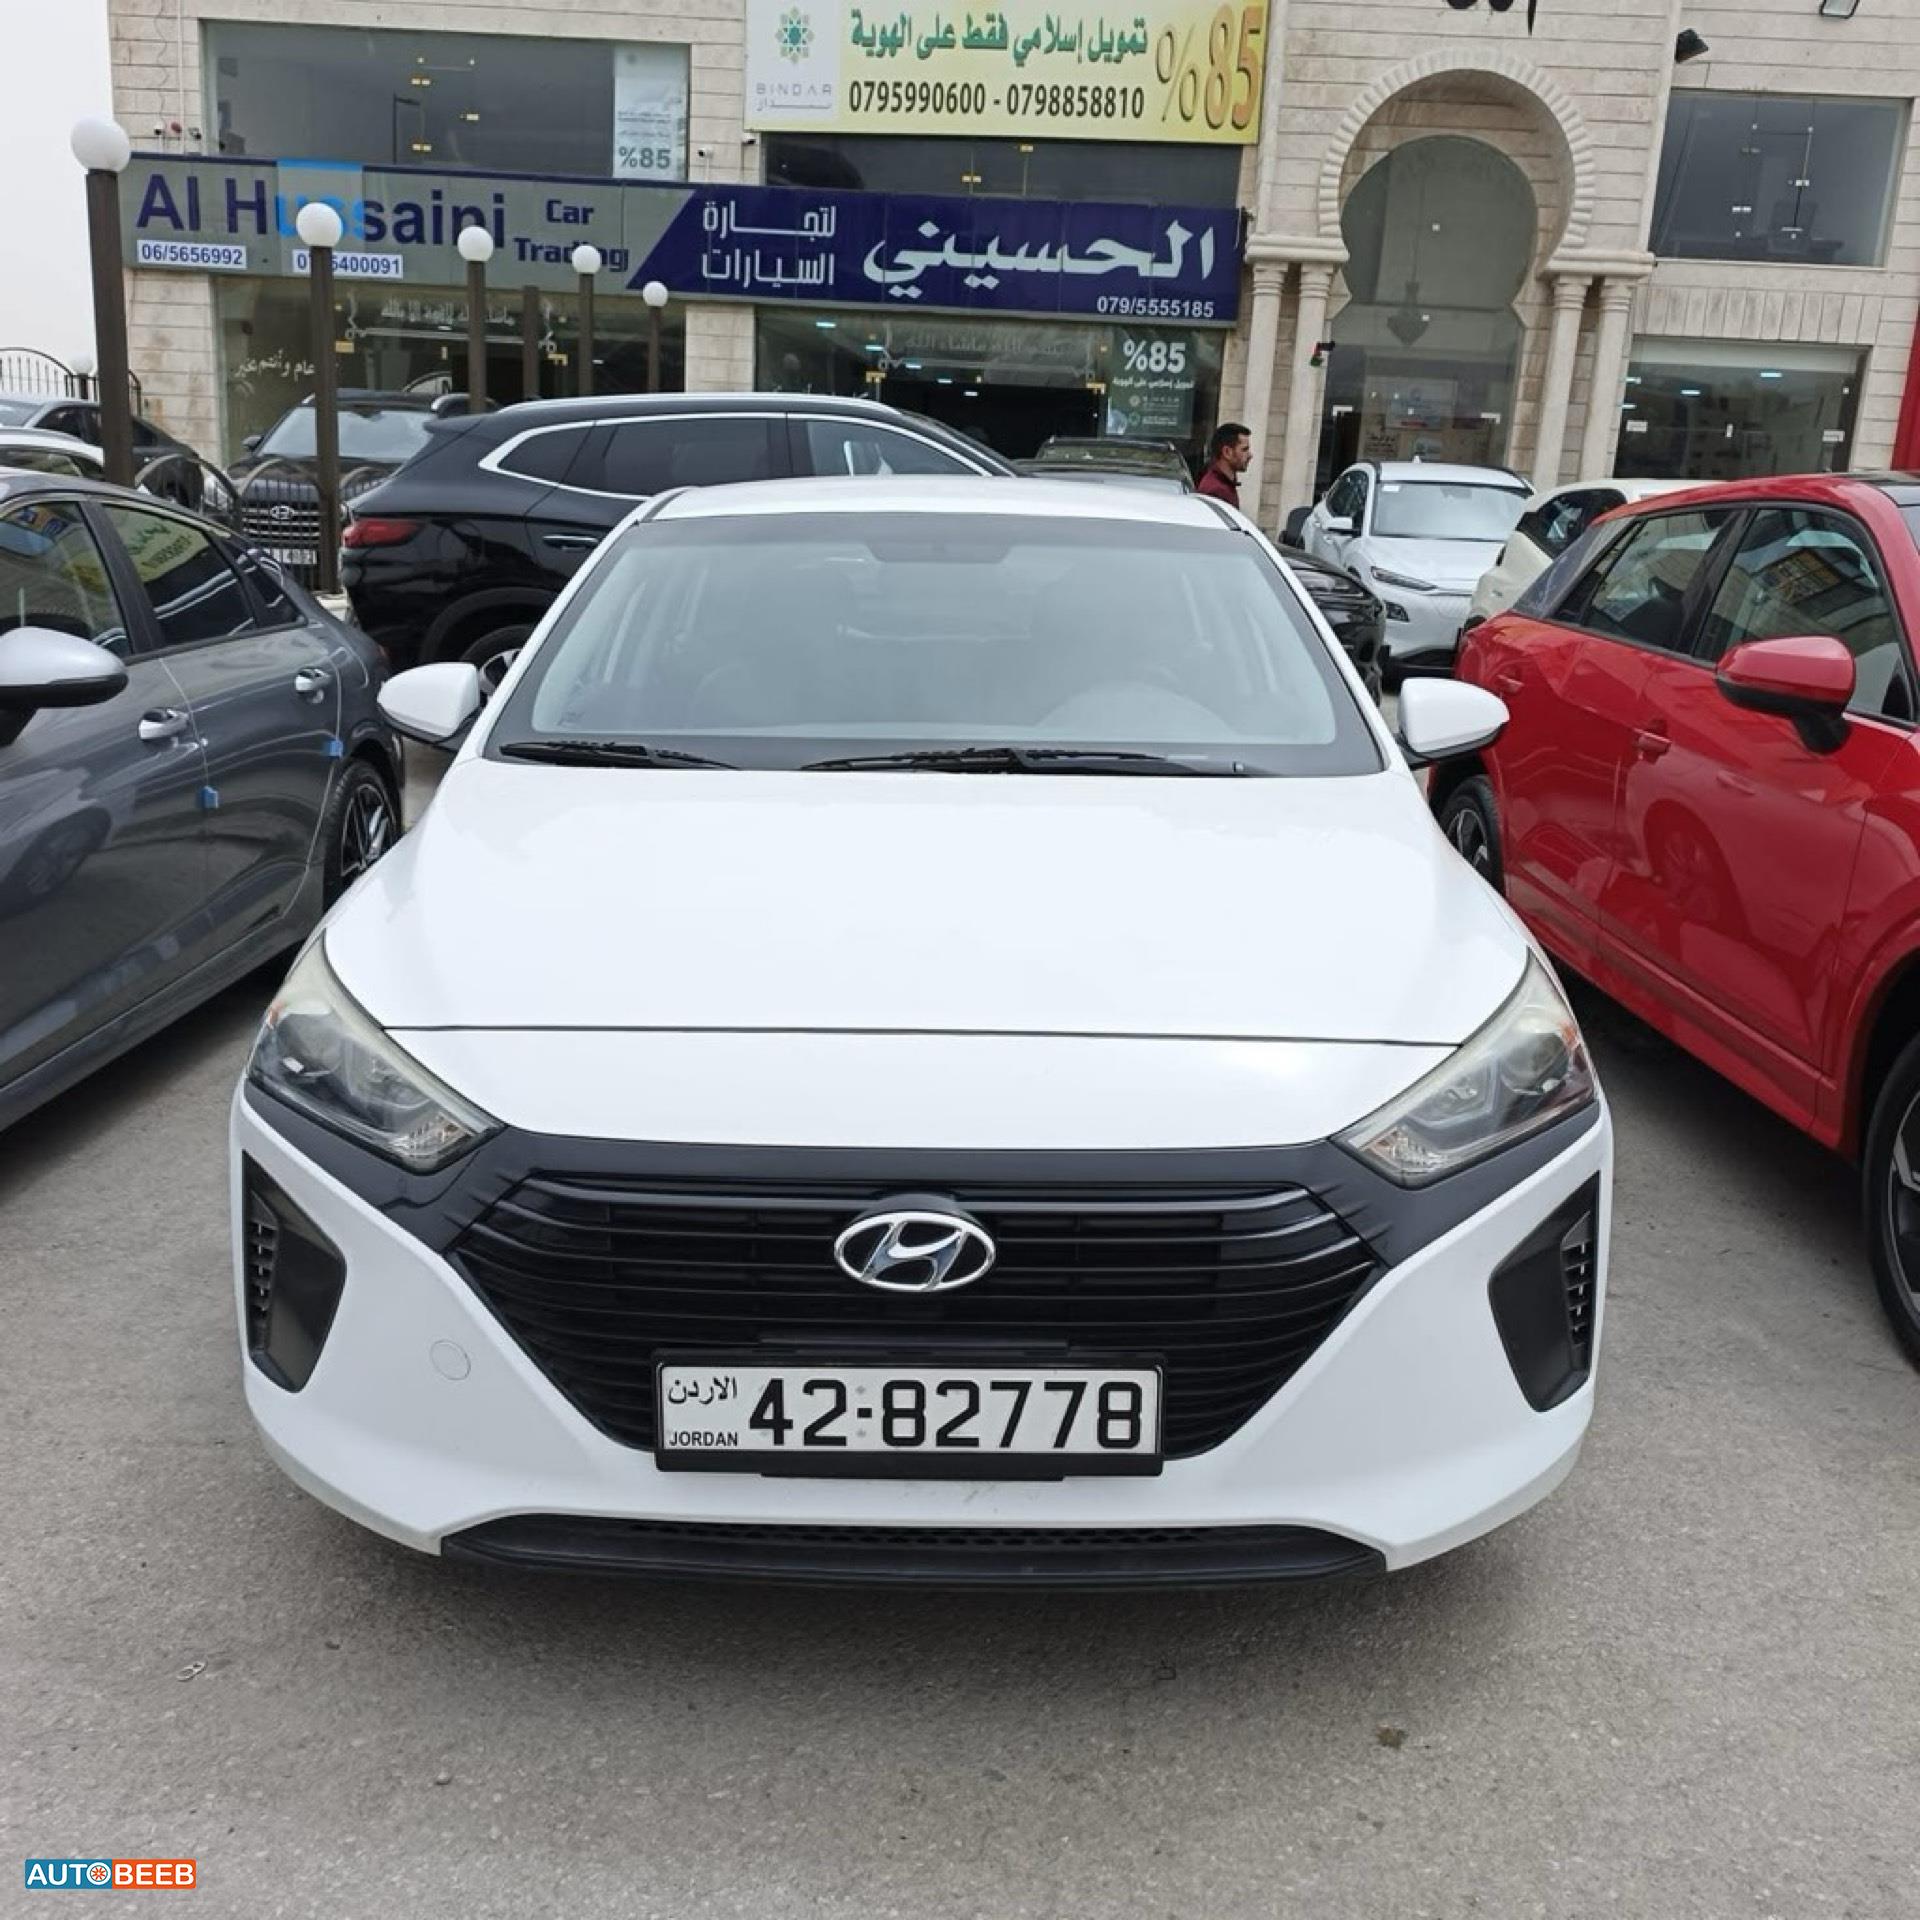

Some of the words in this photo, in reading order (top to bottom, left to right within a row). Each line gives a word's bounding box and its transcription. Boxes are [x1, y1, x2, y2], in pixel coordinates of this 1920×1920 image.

[850, 8, 911, 58] الهوية
[916, 12, 956, 60] على
[961, 11, 1007, 51] فقط
[1014, 11, 1083, 67] إسلامي
[1087, 16, 1147, 63] تمويل
[1155, 4, 1264, 130] %85
[849, 80, 986, 114] 0795990600
[1006, 84, 1144, 118] 0798858810
[618, 146, 671, 169] %85
[136, 173, 200, 232] Al
[546, 199, 594, 225] Car
[142, 243, 243, 266] 06/5656992
[702, 249, 835, 289] السيارات
[863, 219, 1215, 299] الحسيني
[1096, 295, 1215, 318] 079/5555185
[1122, 339, 1186, 373] %85
[749, 1377, 1142, 1449] 42-82778
[669, 1431, 738, 1447] JORDAN
